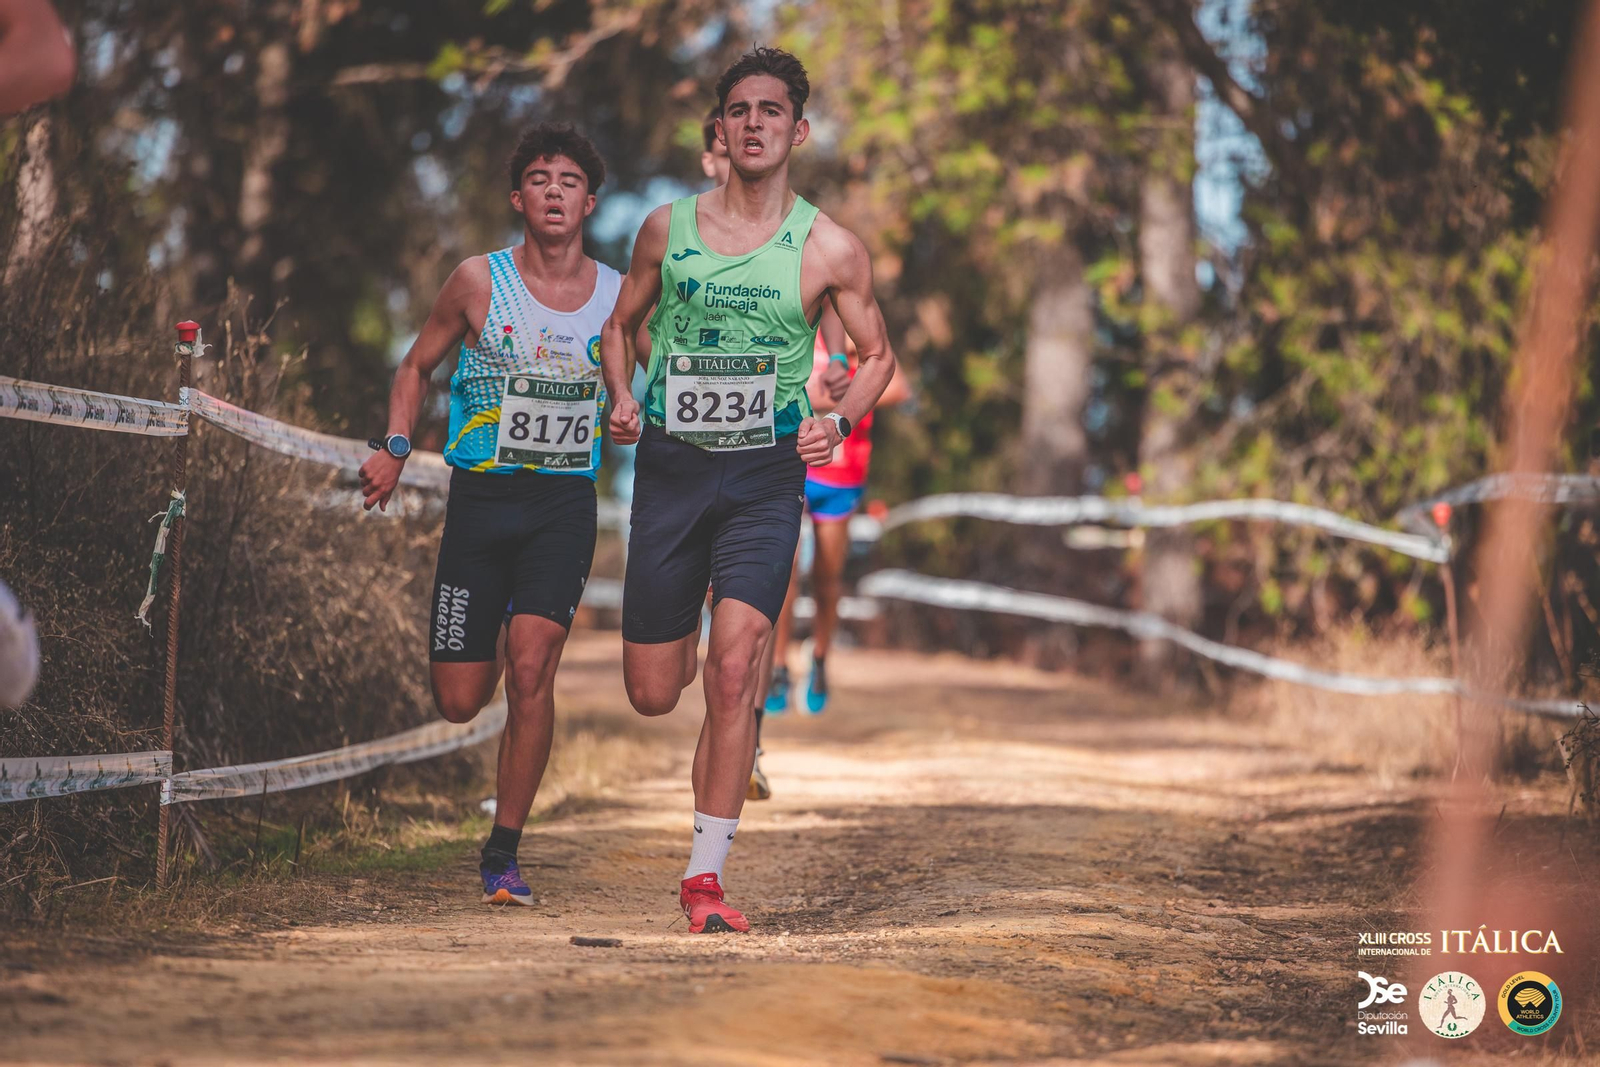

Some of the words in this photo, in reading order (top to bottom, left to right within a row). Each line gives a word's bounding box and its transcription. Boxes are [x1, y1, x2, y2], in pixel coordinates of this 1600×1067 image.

[705, 282, 781, 300] Fundación
[704, 295, 758, 314] Unicaja
[704, 311, 727, 321] Jaén
[699, 357, 750, 370] ITÁLICA
[535, 382, 580, 396] ITÁLICA
[677, 390, 767, 423] 8234
[509, 412, 590, 444] 8176
[434, 583, 452, 652] LUCENA
[447, 586, 470, 652] SURCO
